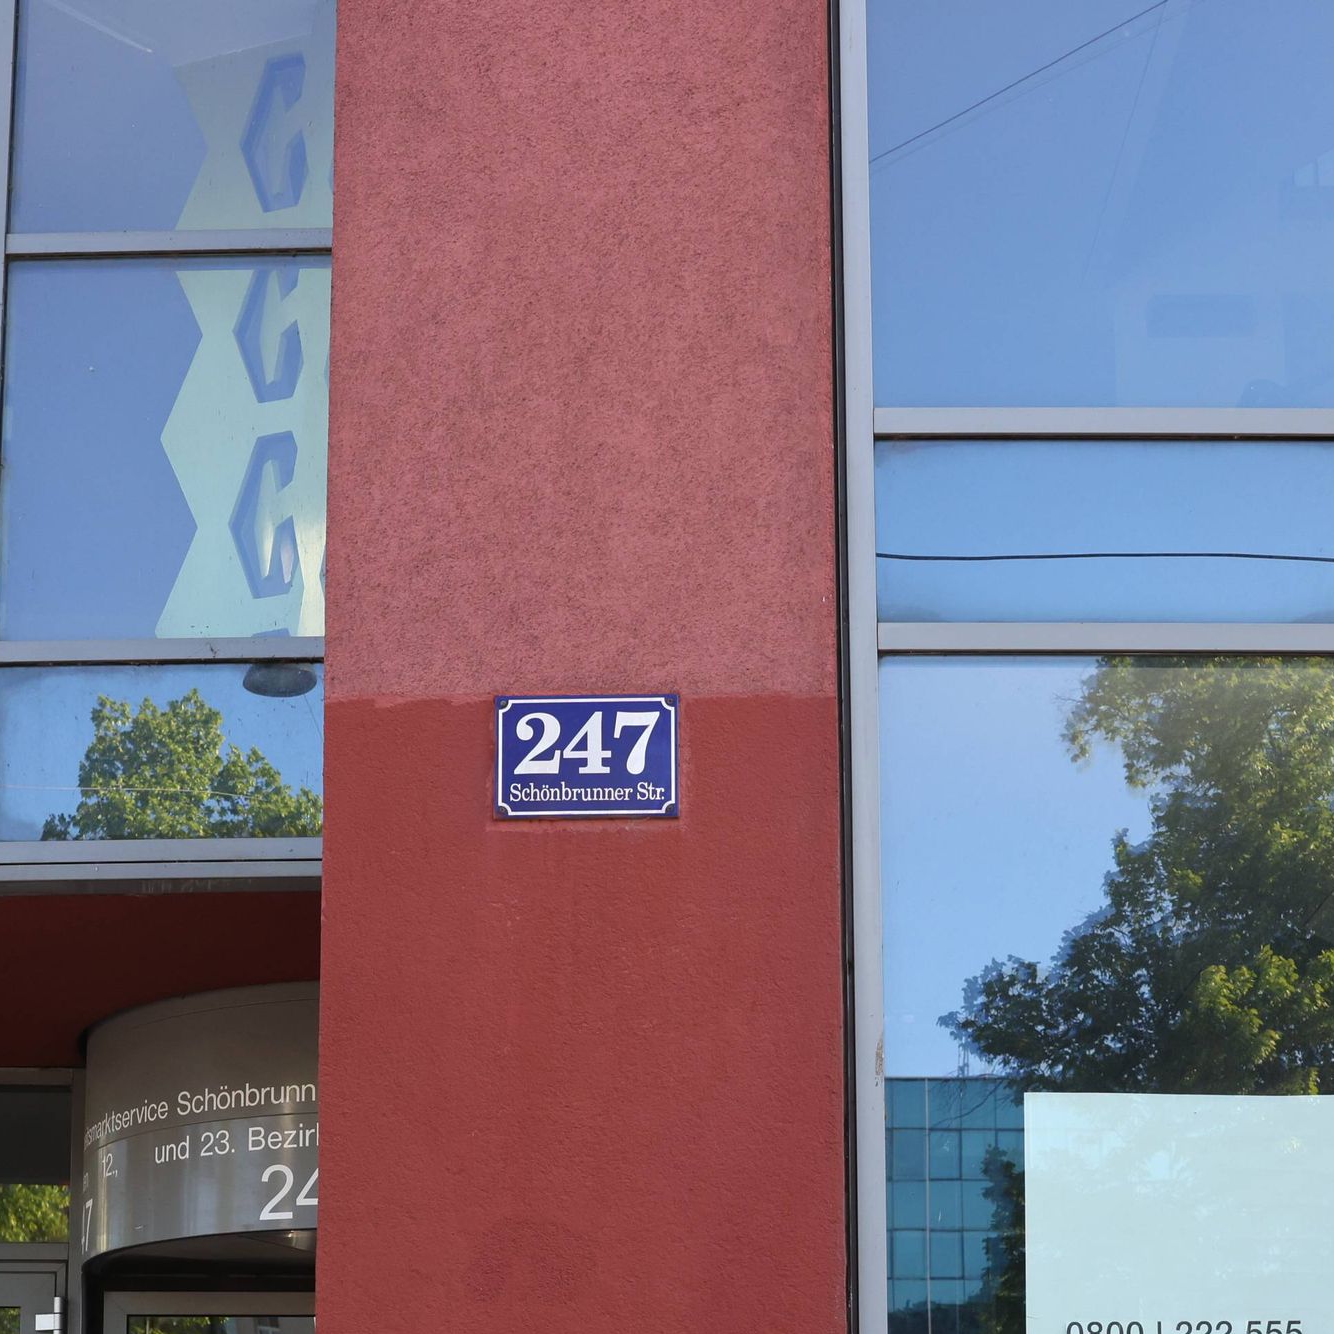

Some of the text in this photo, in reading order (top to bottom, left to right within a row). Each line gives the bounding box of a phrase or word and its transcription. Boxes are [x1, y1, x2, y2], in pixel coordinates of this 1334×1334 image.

[513, 711, 660, 775] 247
[509, 781, 665, 802] Schönbrunner Str.
[155, 1136, 190, 1164] und
[200, 1130, 236, 1157] 23.
[248, 1122, 319, 1151] Bezir
